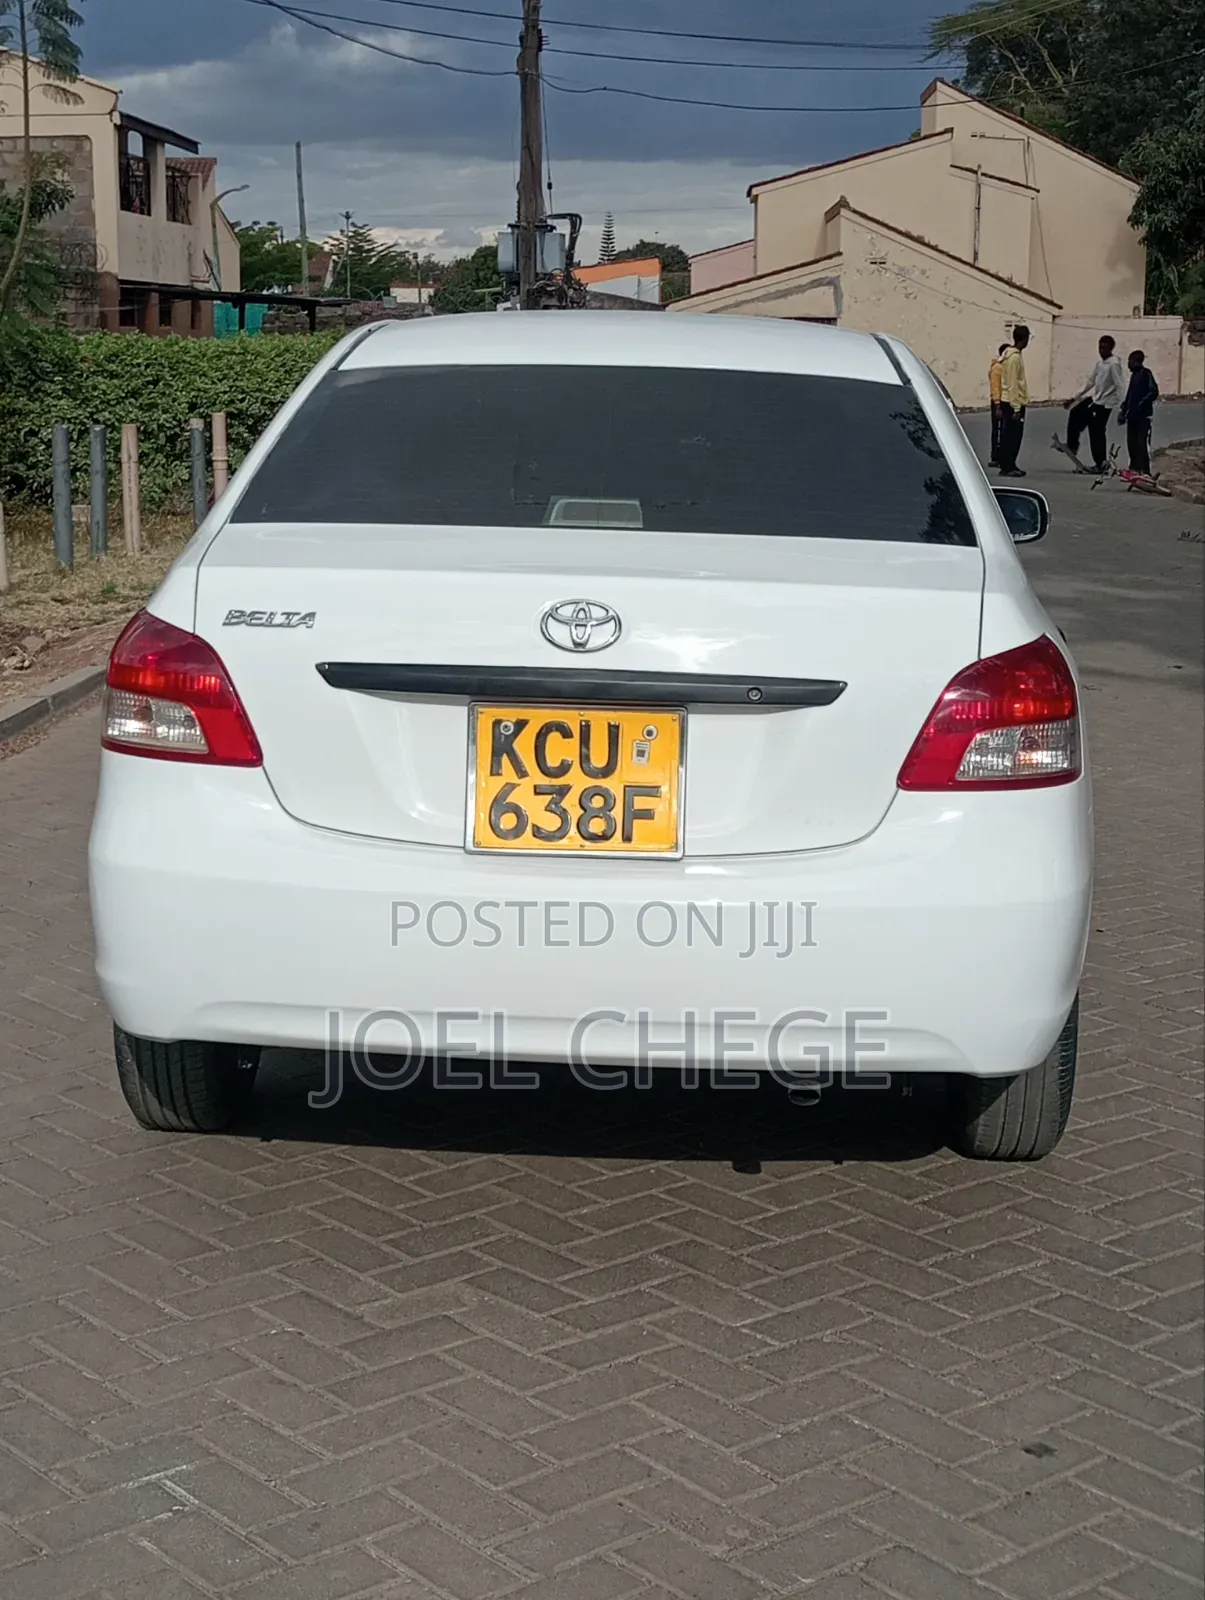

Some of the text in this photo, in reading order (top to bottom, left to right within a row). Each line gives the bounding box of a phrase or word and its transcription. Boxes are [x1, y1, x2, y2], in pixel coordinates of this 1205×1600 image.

[222, 609, 317, 628] BELTA
[489, 718, 620, 780] KCU
[488, 782, 662, 843] 638F
